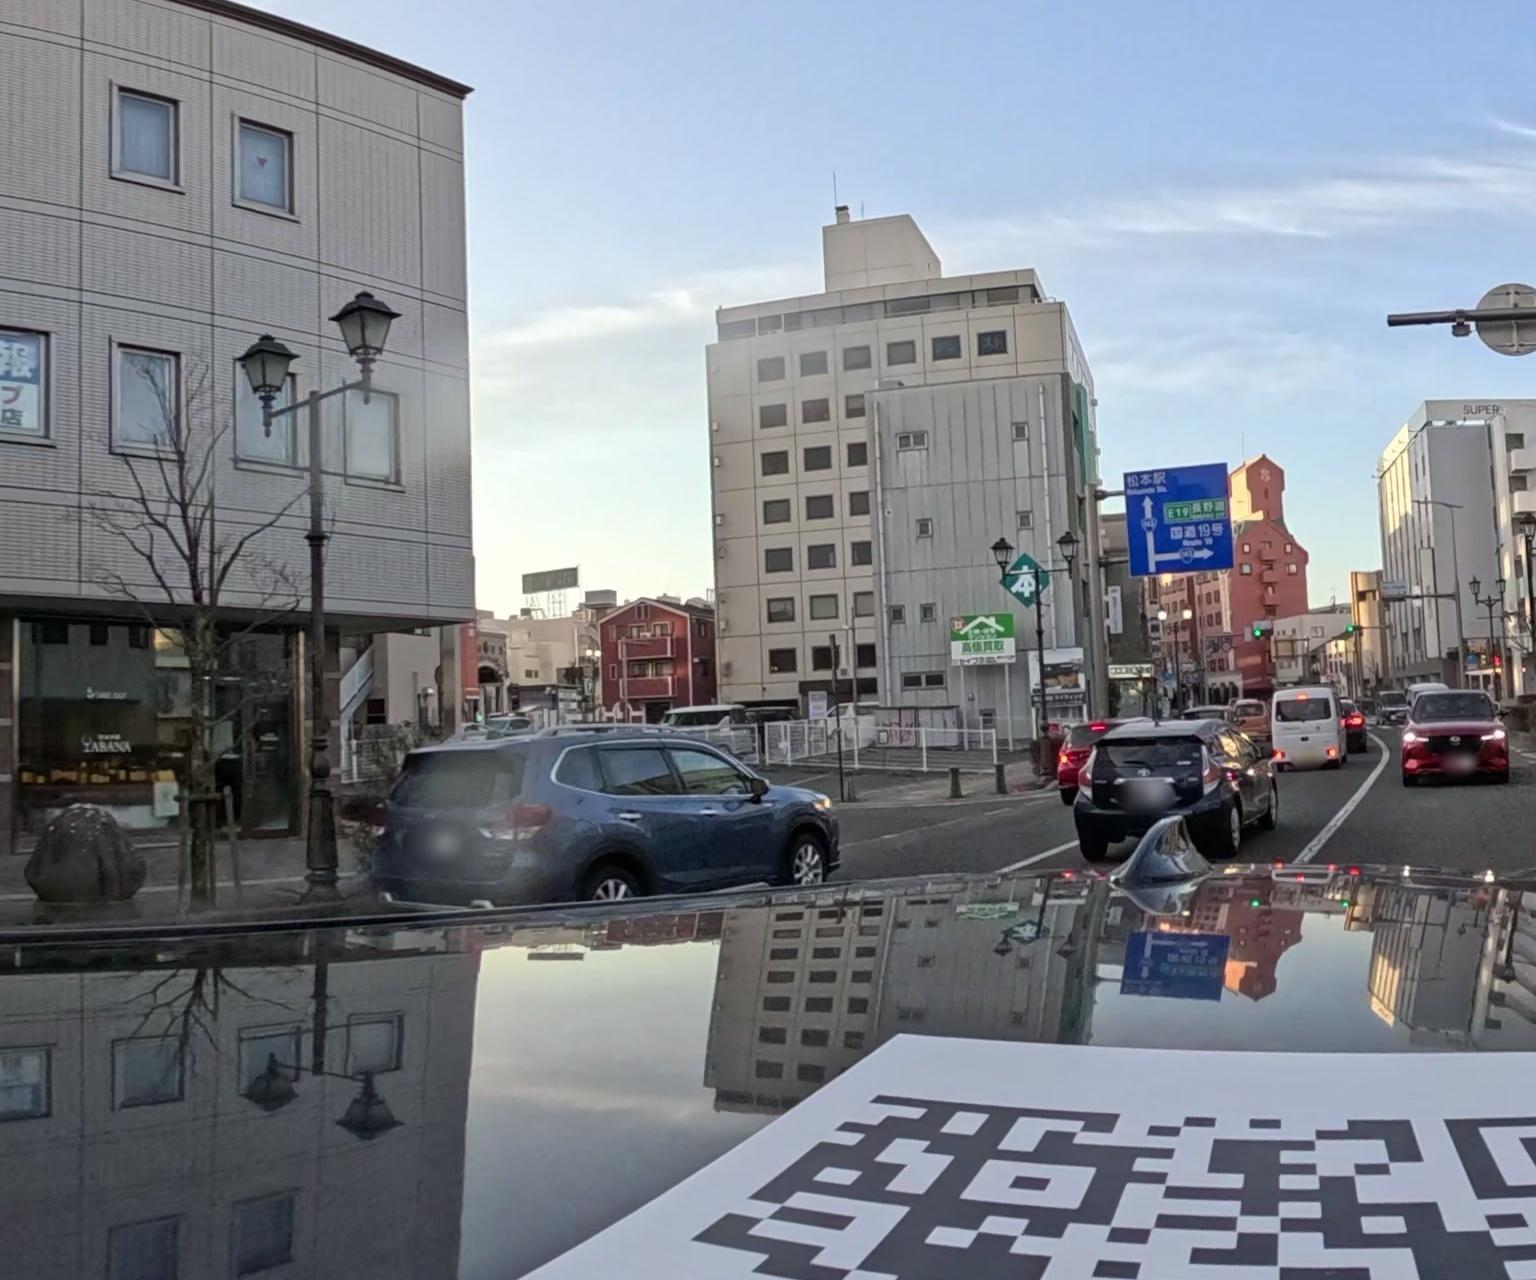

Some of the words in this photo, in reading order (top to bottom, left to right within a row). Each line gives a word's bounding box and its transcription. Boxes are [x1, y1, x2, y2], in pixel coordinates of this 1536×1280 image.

[1, 408, 23, 426] 店
[1463, 404, 1500, 415] SUPER
[1126, 471, 1167, 488] 松本駅
[1167, 506, 1190, 519] E19
[1170, 523, 1224, 540] 国道19号
